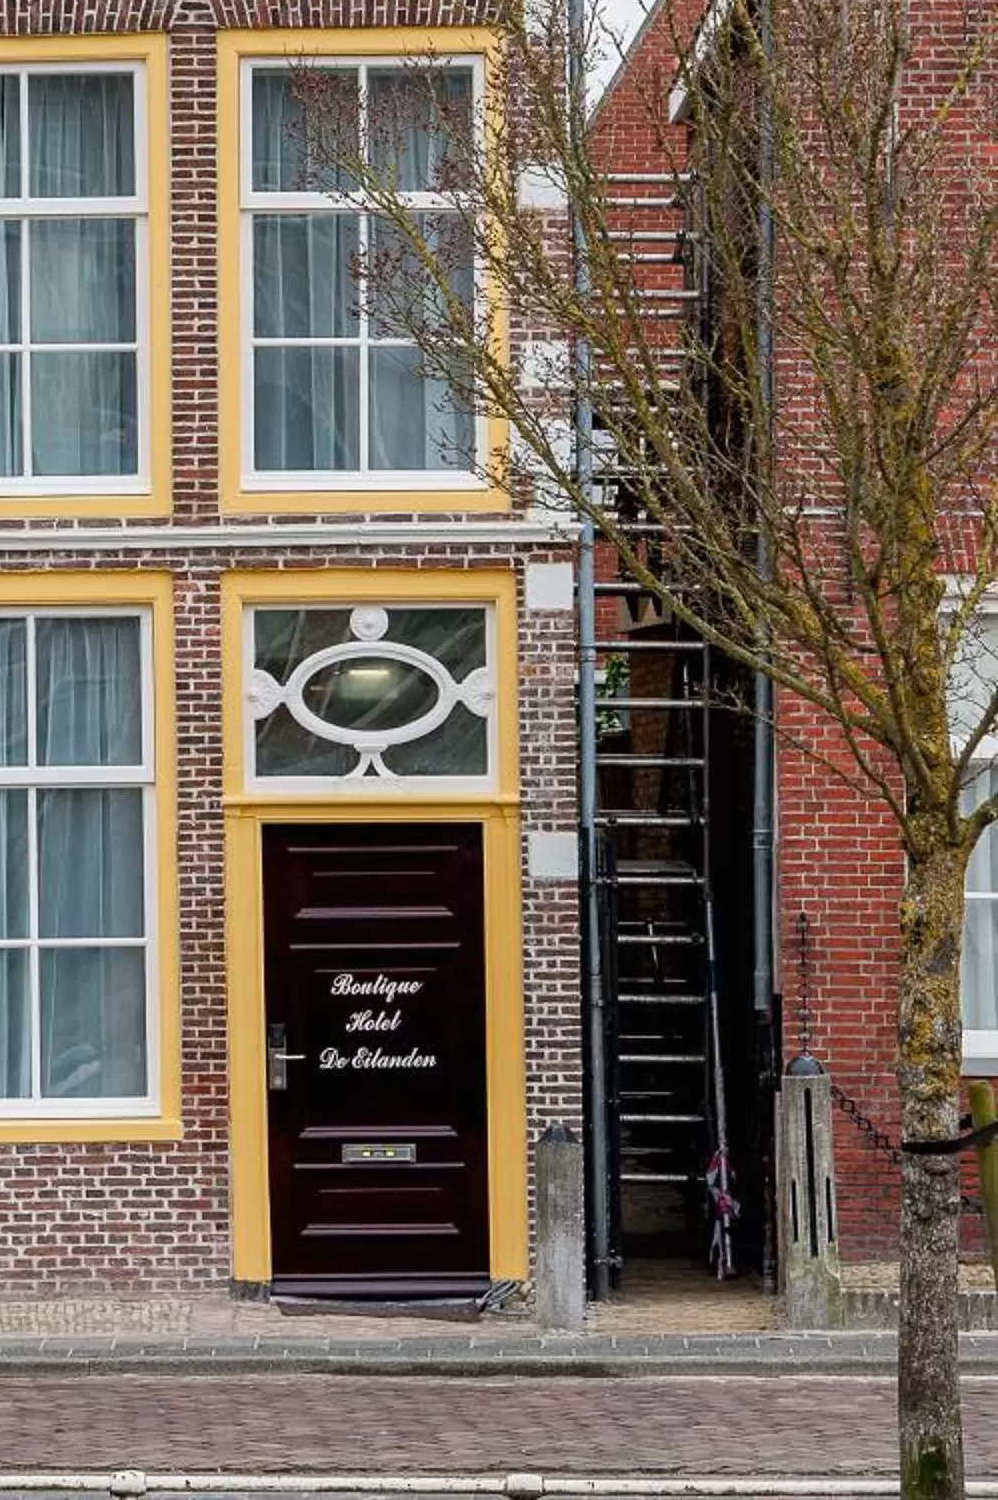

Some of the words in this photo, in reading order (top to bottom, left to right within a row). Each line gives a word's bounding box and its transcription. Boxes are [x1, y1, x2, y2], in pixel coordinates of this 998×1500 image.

[330, 973, 424, 1003] Boutique
[345, 1009, 403, 1033] Hotel
[319, 1047, 350, 1069] De
[351, 1046, 437, 1069] Eilanden
